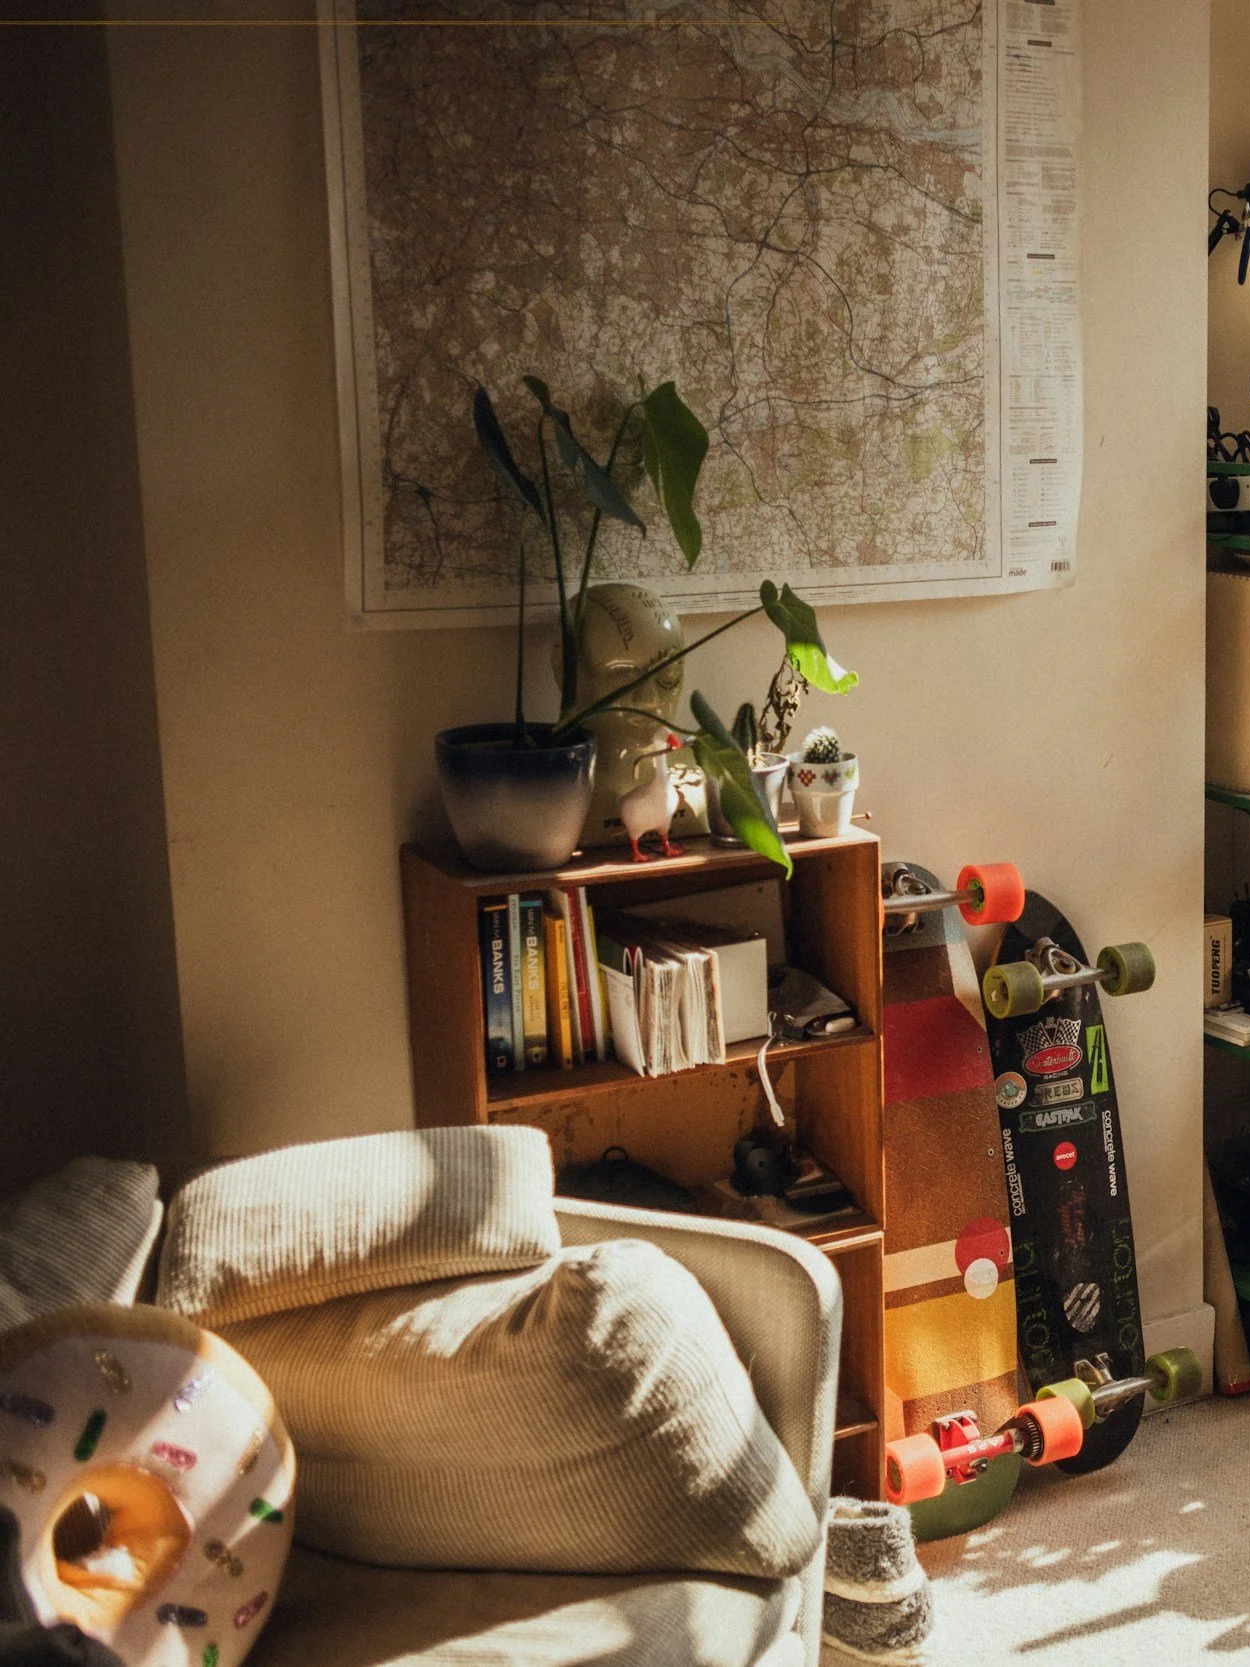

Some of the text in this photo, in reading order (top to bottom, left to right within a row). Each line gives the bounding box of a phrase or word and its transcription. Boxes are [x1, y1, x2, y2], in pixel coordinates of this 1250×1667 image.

[492, 940, 505, 994] BANKS
[525, 936, 539, 990] BANKS
[1210, 938, 1221, 996] TUOPENG
[1042, 1070, 1068, 1080] RACING
[1035, 1106, 1083, 1128] EASTPAK
[1103, 1109, 1115, 1161] concrete
[1003, 1128, 1015, 1162] wave
[1055, 1152, 1075, 1161] avocet
[1006, 1162, 1022, 1217] concrete
[1108, 1161, 1118, 1197] wave
